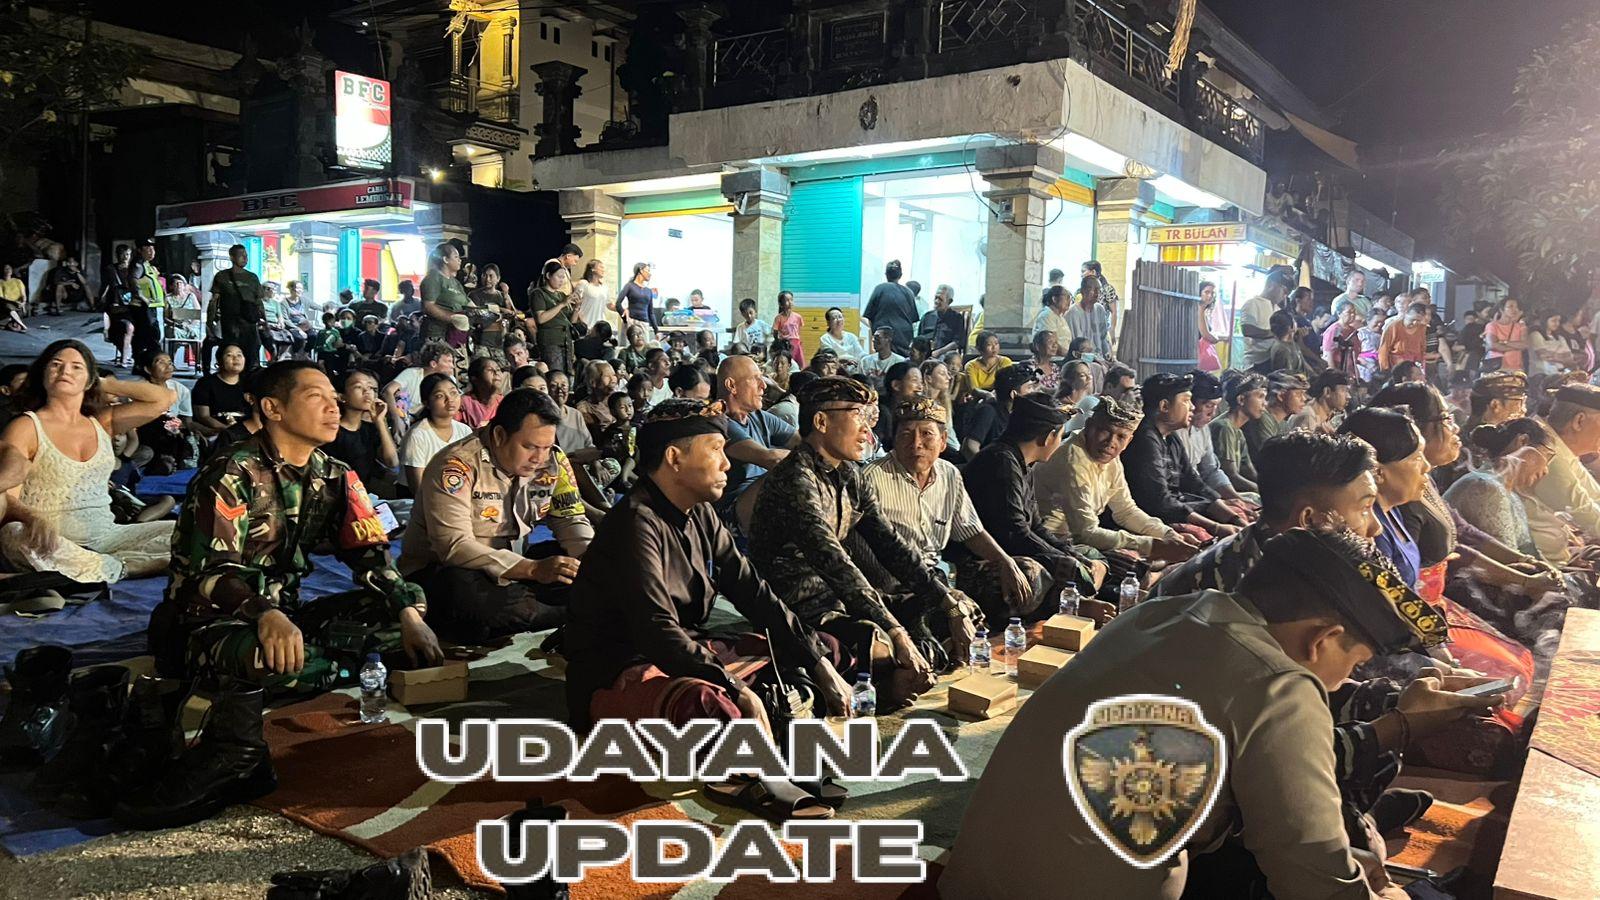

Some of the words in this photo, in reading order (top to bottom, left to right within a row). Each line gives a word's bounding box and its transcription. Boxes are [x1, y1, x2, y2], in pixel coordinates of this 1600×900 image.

[343, 77, 384, 102] BFC
[240, 193, 298, 211] BFC
[1166, 230, 1181, 240] TR
[1184, 228, 1228, 240] BULAN
